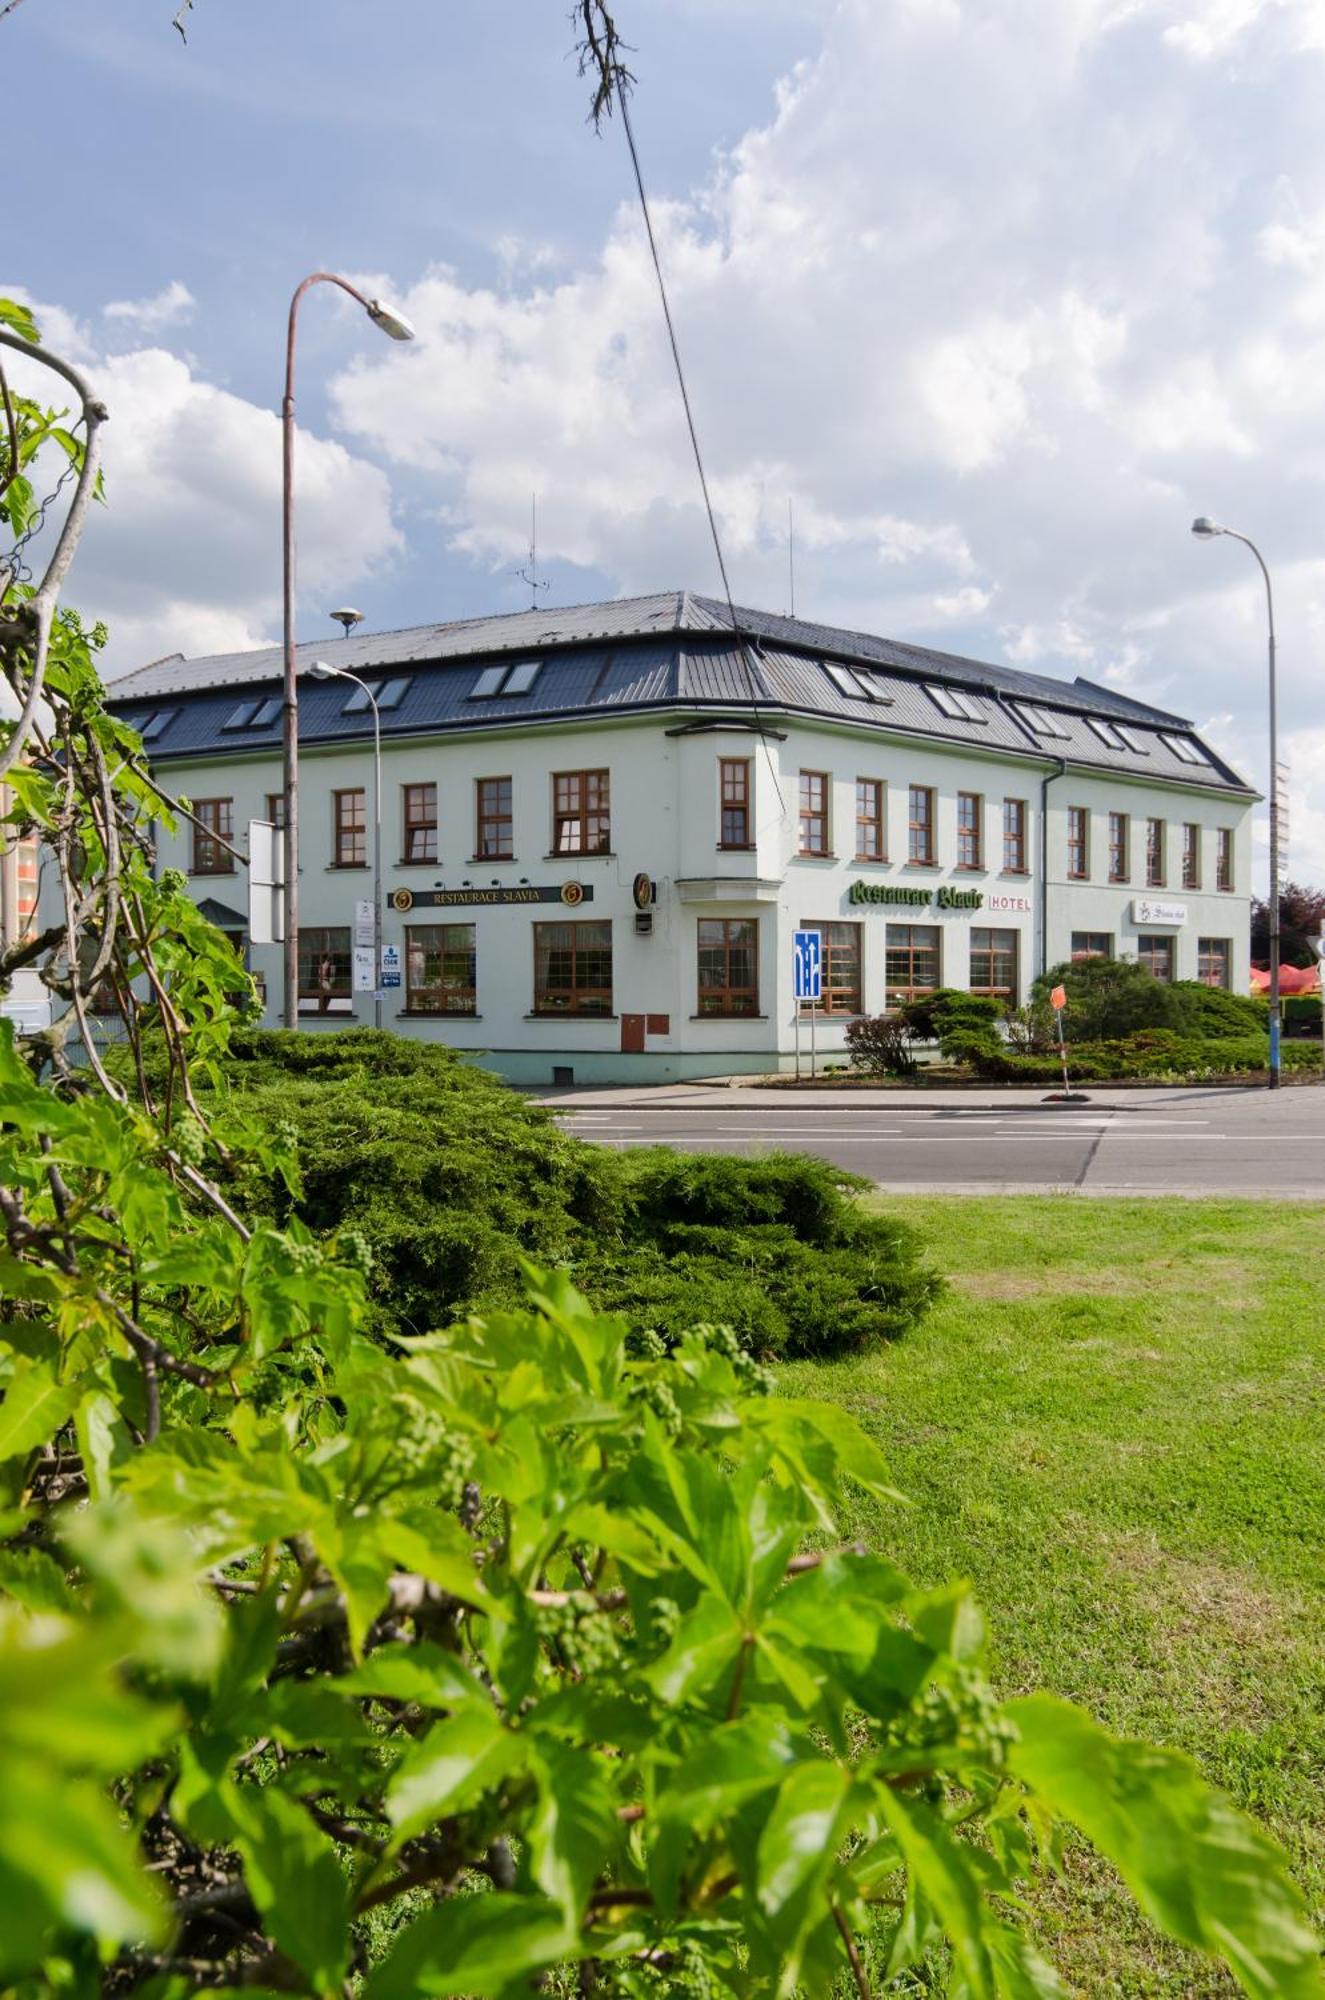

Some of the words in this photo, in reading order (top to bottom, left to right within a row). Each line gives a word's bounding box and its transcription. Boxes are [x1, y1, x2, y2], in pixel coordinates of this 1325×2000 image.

[433, 891, 498, 904] RESTAURACE
[503, 890, 540, 903] SLAVIA
[992, 896, 1031, 910] HOTEL
